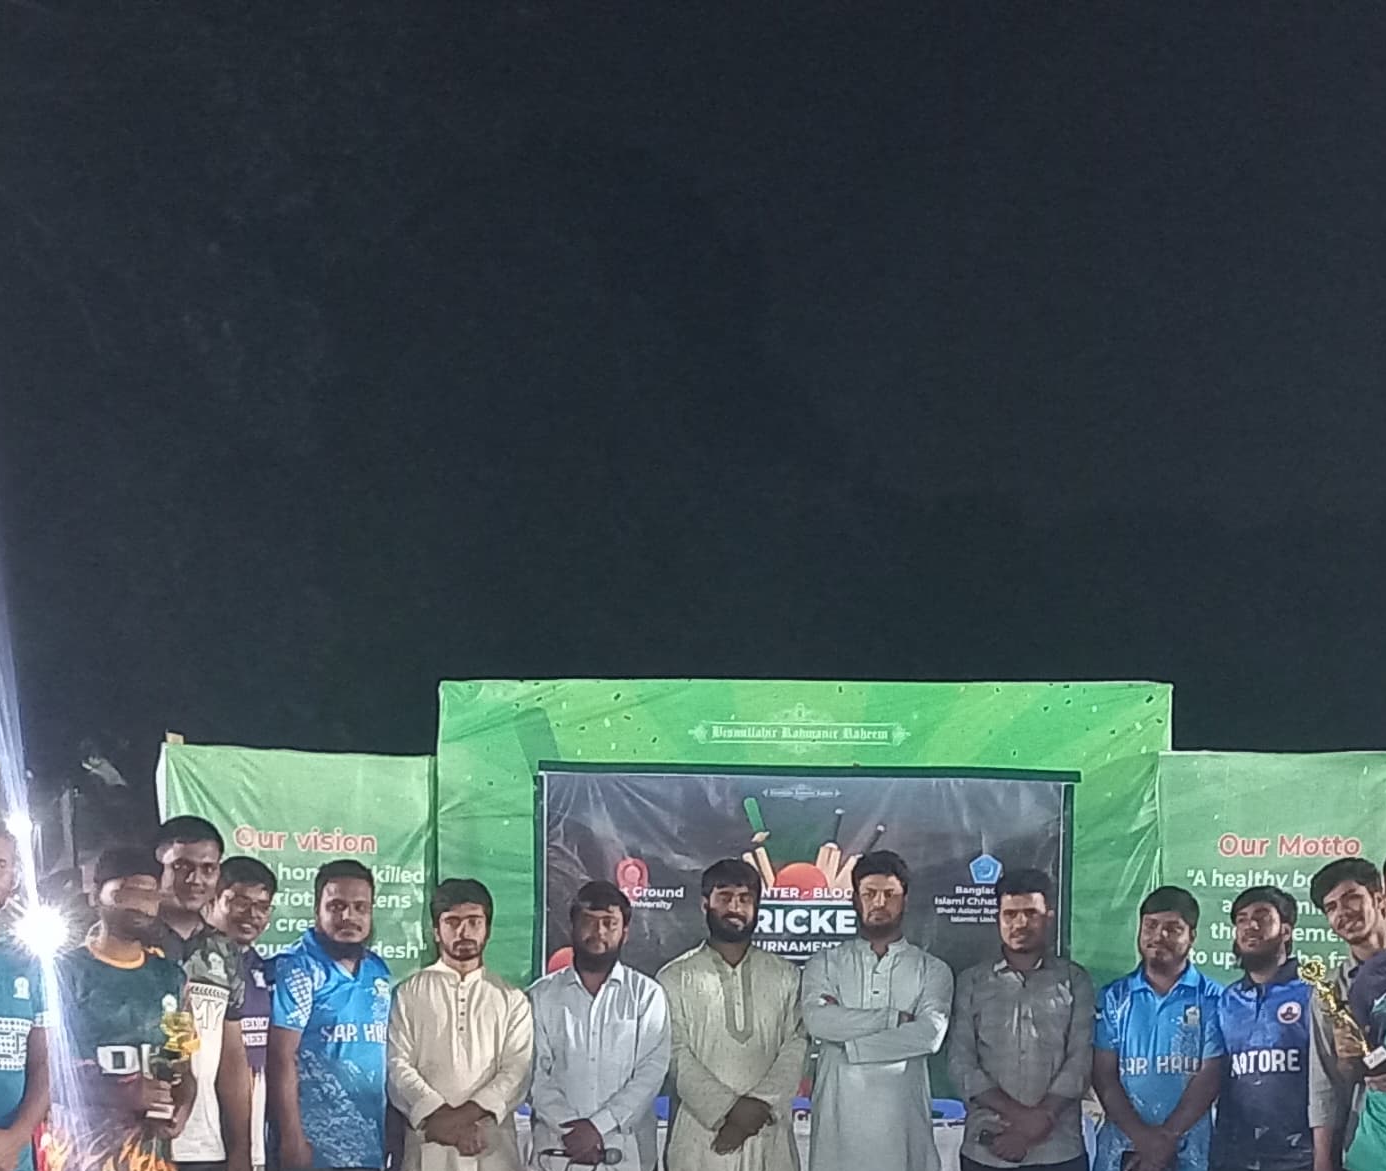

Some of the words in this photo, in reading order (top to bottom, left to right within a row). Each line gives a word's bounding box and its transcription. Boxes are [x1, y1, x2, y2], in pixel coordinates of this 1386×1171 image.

[233, 824, 288, 851] Our
[295, 826, 378, 855] vision
[1218, 832, 1270, 858] Our
[1277, 833, 1363, 859] Motto
[372, 865, 426, 884] killed
[1212, 869, 1289, 888] healthy
[373, 894, 413, 909] ens
[632, 886, 685, 898] Ground
[761, 887, 800, 899] NTER
[754, 908, 858, 935] RICKE
[1187, 947, 1208, 965] to
[1212, 950, 1238, 971] up
